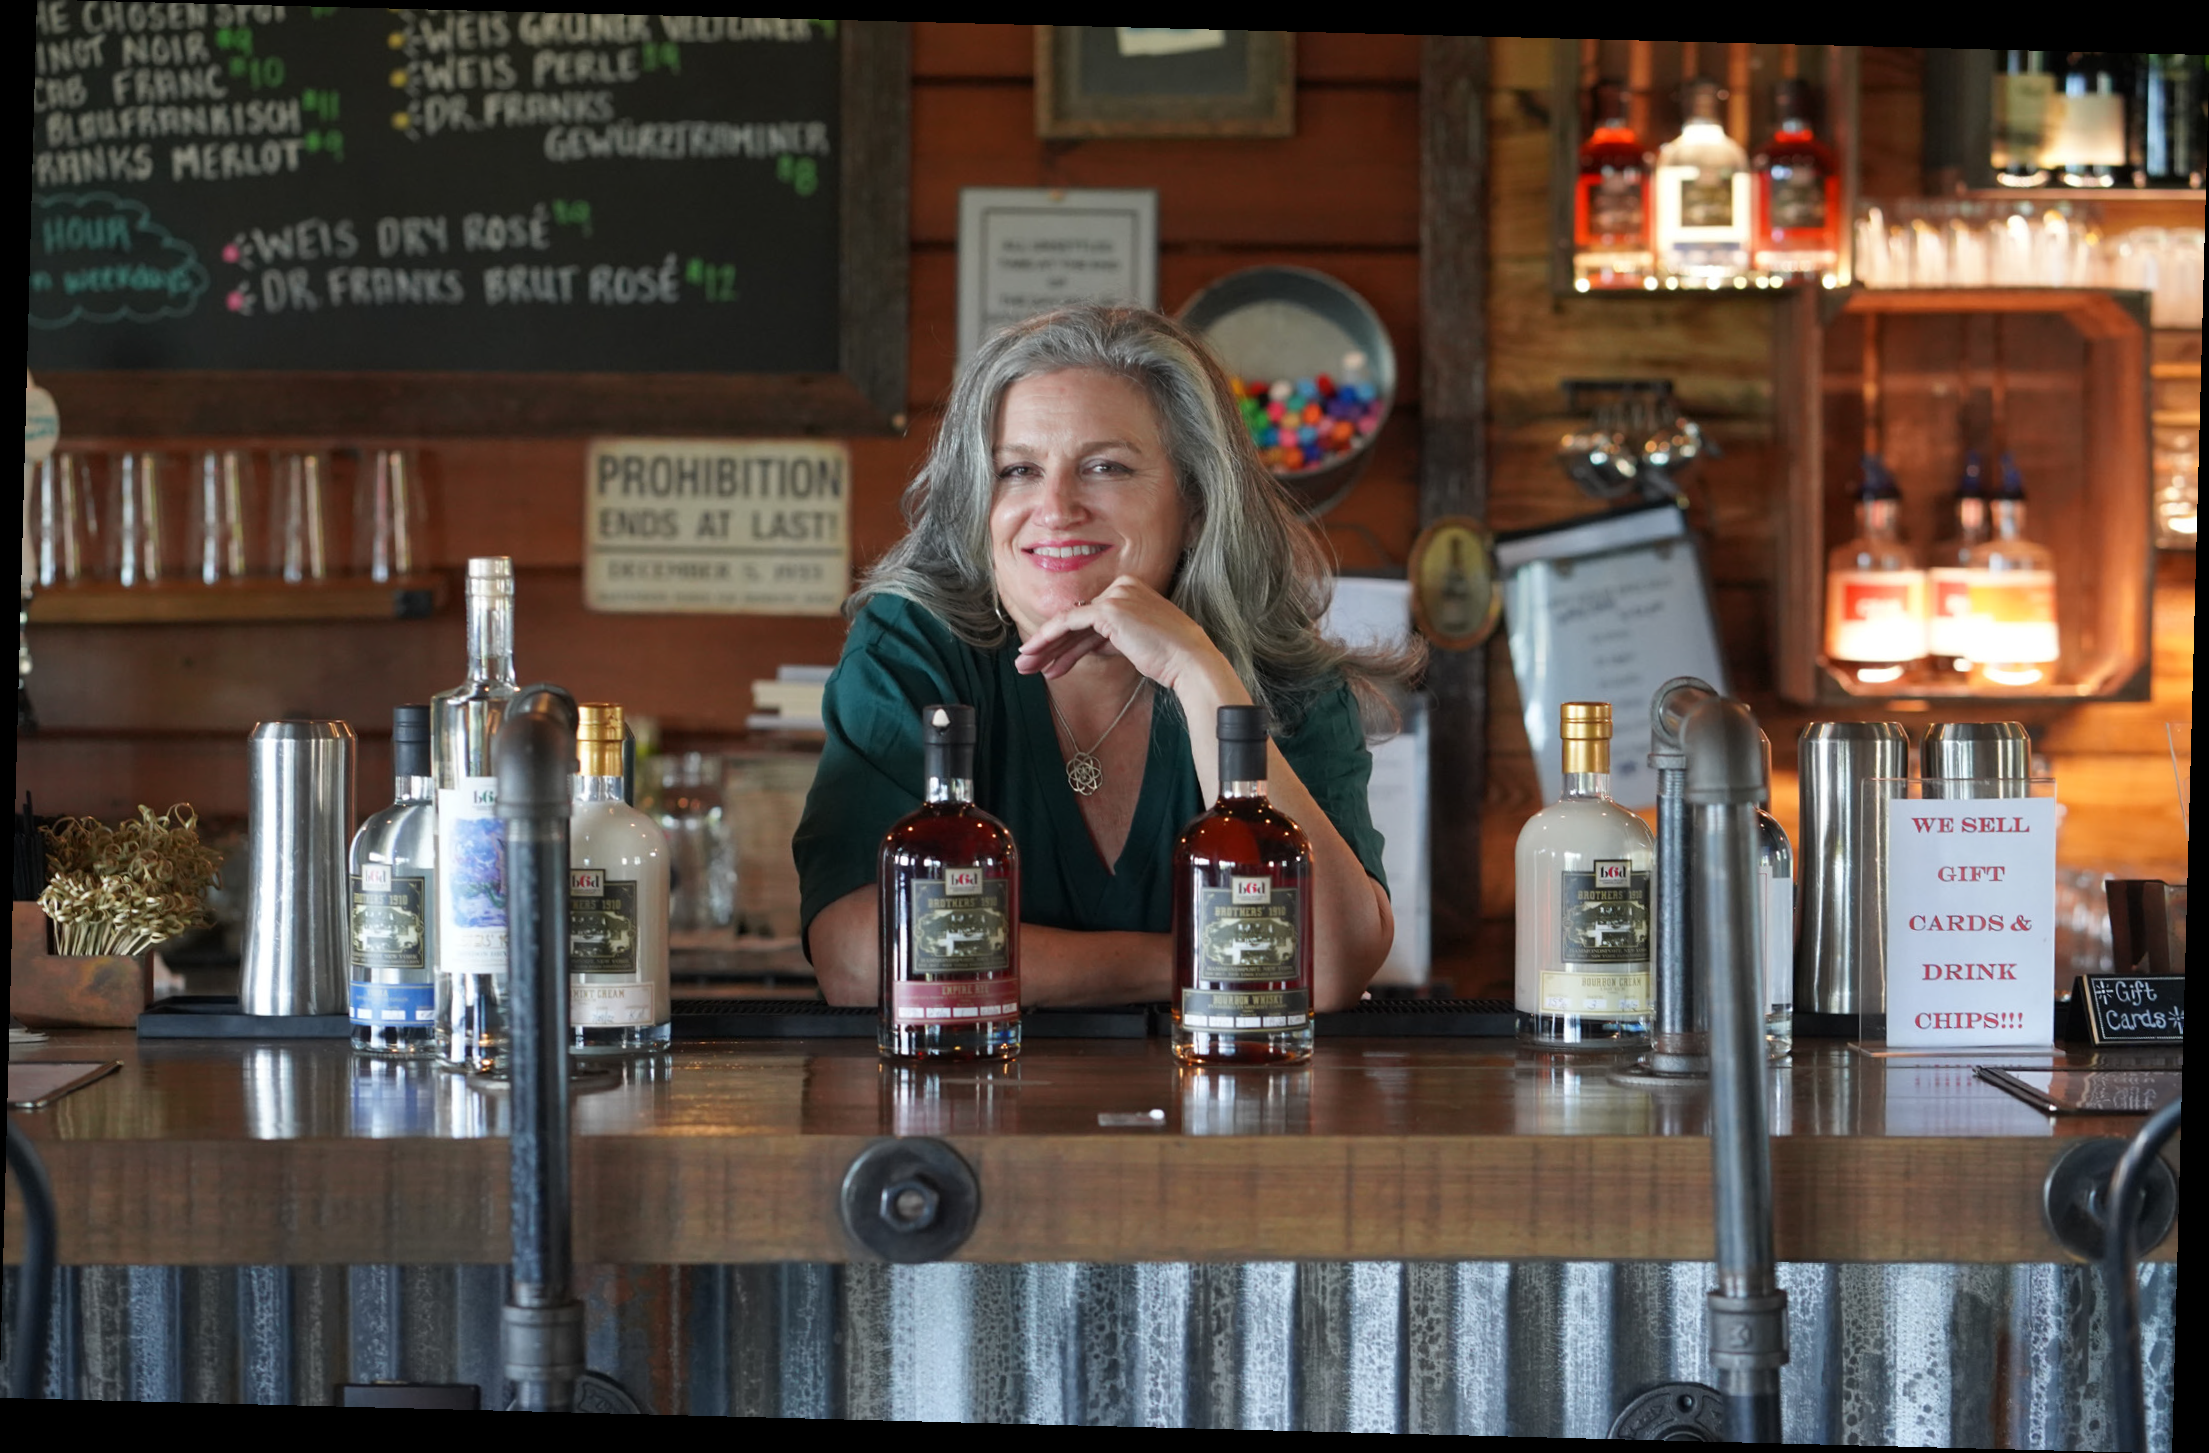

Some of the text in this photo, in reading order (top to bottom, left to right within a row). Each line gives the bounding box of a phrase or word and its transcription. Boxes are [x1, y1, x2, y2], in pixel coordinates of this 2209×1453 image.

[81, 3, 207, 33] CHOSEN
[420, 11, 511, 52] WEIS
[121, 30, 211, 67] NOIR
[422, 52, 517, 91] WEIS
[532, 48, 640, 88] PERLE
[111, 62, 228, 105] FRANC
[482, 91, 616, 129] FRANKS
[171, 137, 305, 182] MERLOT
[42, 214, 132, 254] HOUR
[250, 217, 360, 264] WEIS
[376, 214, 450, 258] DRY
[462, 202, 550, 252] ROSÉ
[326, 265, 465, 307] FRANKS
[482, 263, 580, 306] BRUT
[588, 250, 681, 306] ROSÉ
[598, 455, 843, 498] PROHIBITION
[600, 507, 679, 541] ENDS
[697, 509, 733, 541] AT
[1911, 817, 2030, 833] WE SELL
[1937, 866, 2005, 882] GIFT
[389, 894, 409, 906] 1910
[602, 899, 622, 911] 1910
[1215, 906, 1286, 917] BROTHERS' 1910
[1908, 915, 2032, 932] CARDS &
[1581, 977, 1642, 988] BOURBON CREAM
[1922, 964, 2017, 981] DRINK
[597, 989, 625, 999] CREAM
[942, 984, 990, 996] EMPIRE RYE
[1213, 995, 1249, 1006] BOURBON
[2115, 981, 2157, 1006] Gift
[1914, 1012, 2024, 1029] CHIPS!!!
[2106, 1009, 2167, 1031] Cards
